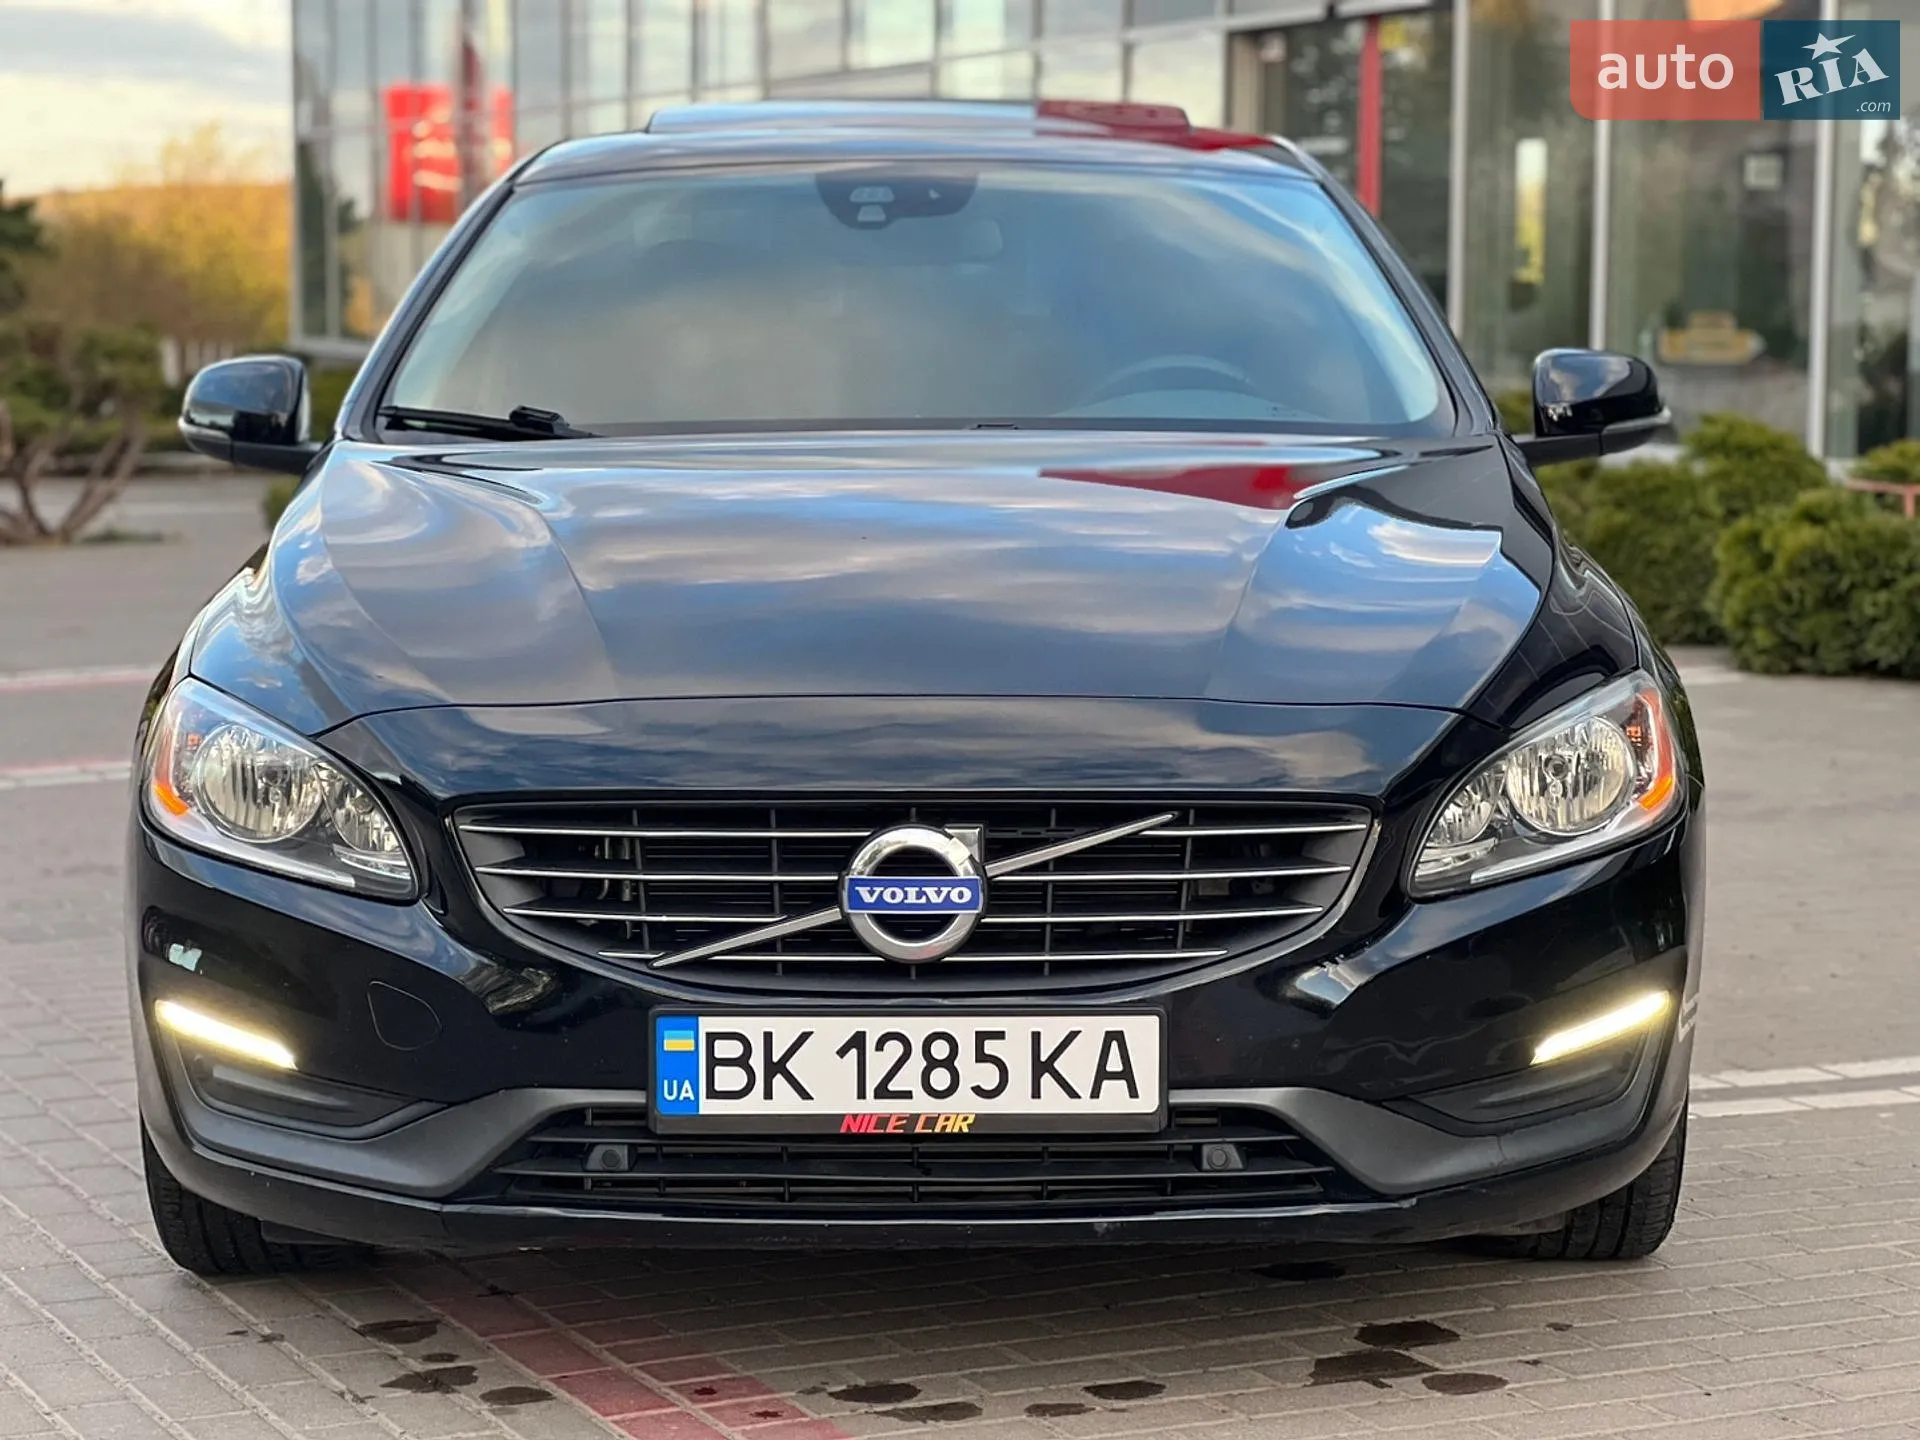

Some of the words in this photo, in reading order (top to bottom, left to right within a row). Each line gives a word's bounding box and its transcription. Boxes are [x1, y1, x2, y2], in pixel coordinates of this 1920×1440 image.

[855, 886, 972, 904] VOLVO
[705, 1030, 814, 1100] BK
[836, 1030, 1009, 1100] 1285
[1030, 1030, 1140, 1100] KA
[663, 1079, 695, 1101] UA
[840, 1113, 910, 1133] NICE
[914, 1113, 976, 1133] CAR
